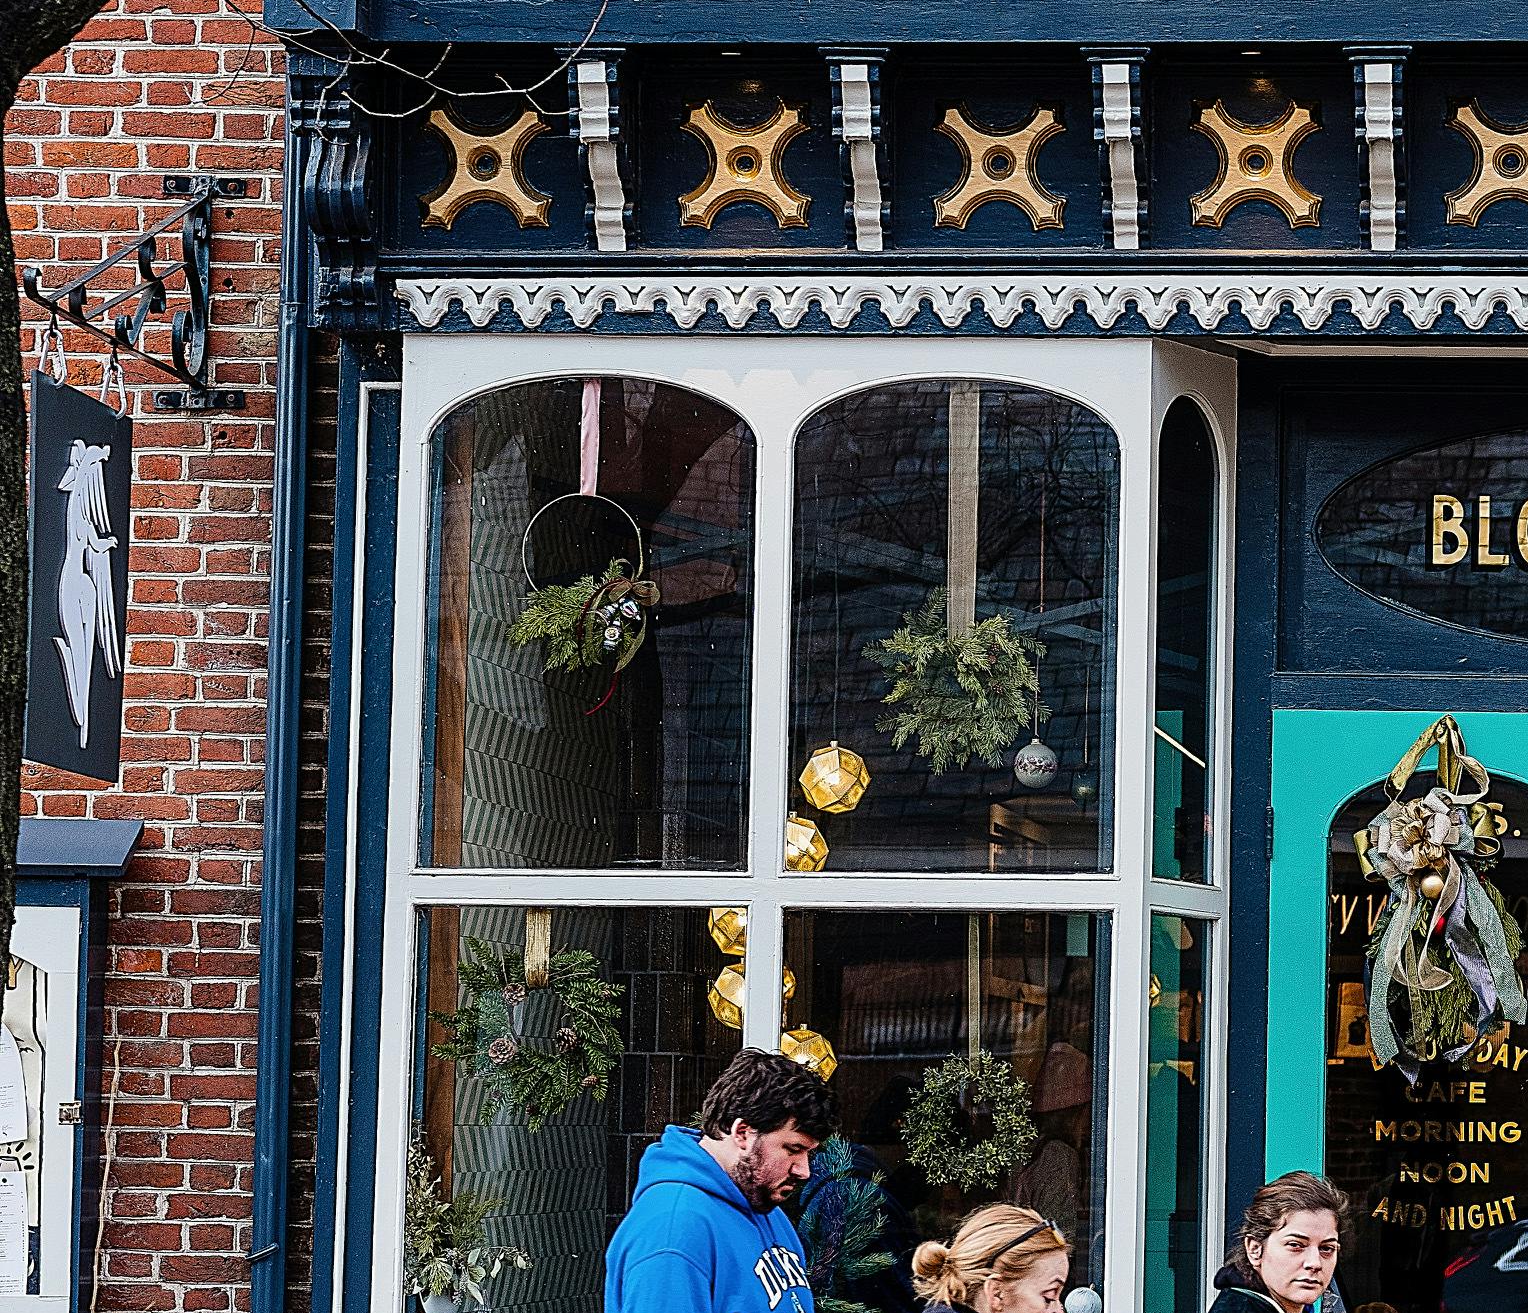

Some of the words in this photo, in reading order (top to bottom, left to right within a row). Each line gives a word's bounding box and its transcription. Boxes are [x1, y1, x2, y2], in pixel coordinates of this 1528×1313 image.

[1405, 1081, 1487, 1104] CAFE
[1375, 1120, 1522, 1143] MORNING
[1400, 1162, 1490, 1184] NOON
[1371, 1196, 1427, 1228] AND
[1440, 1195, 1518, 1231] NIGHT
